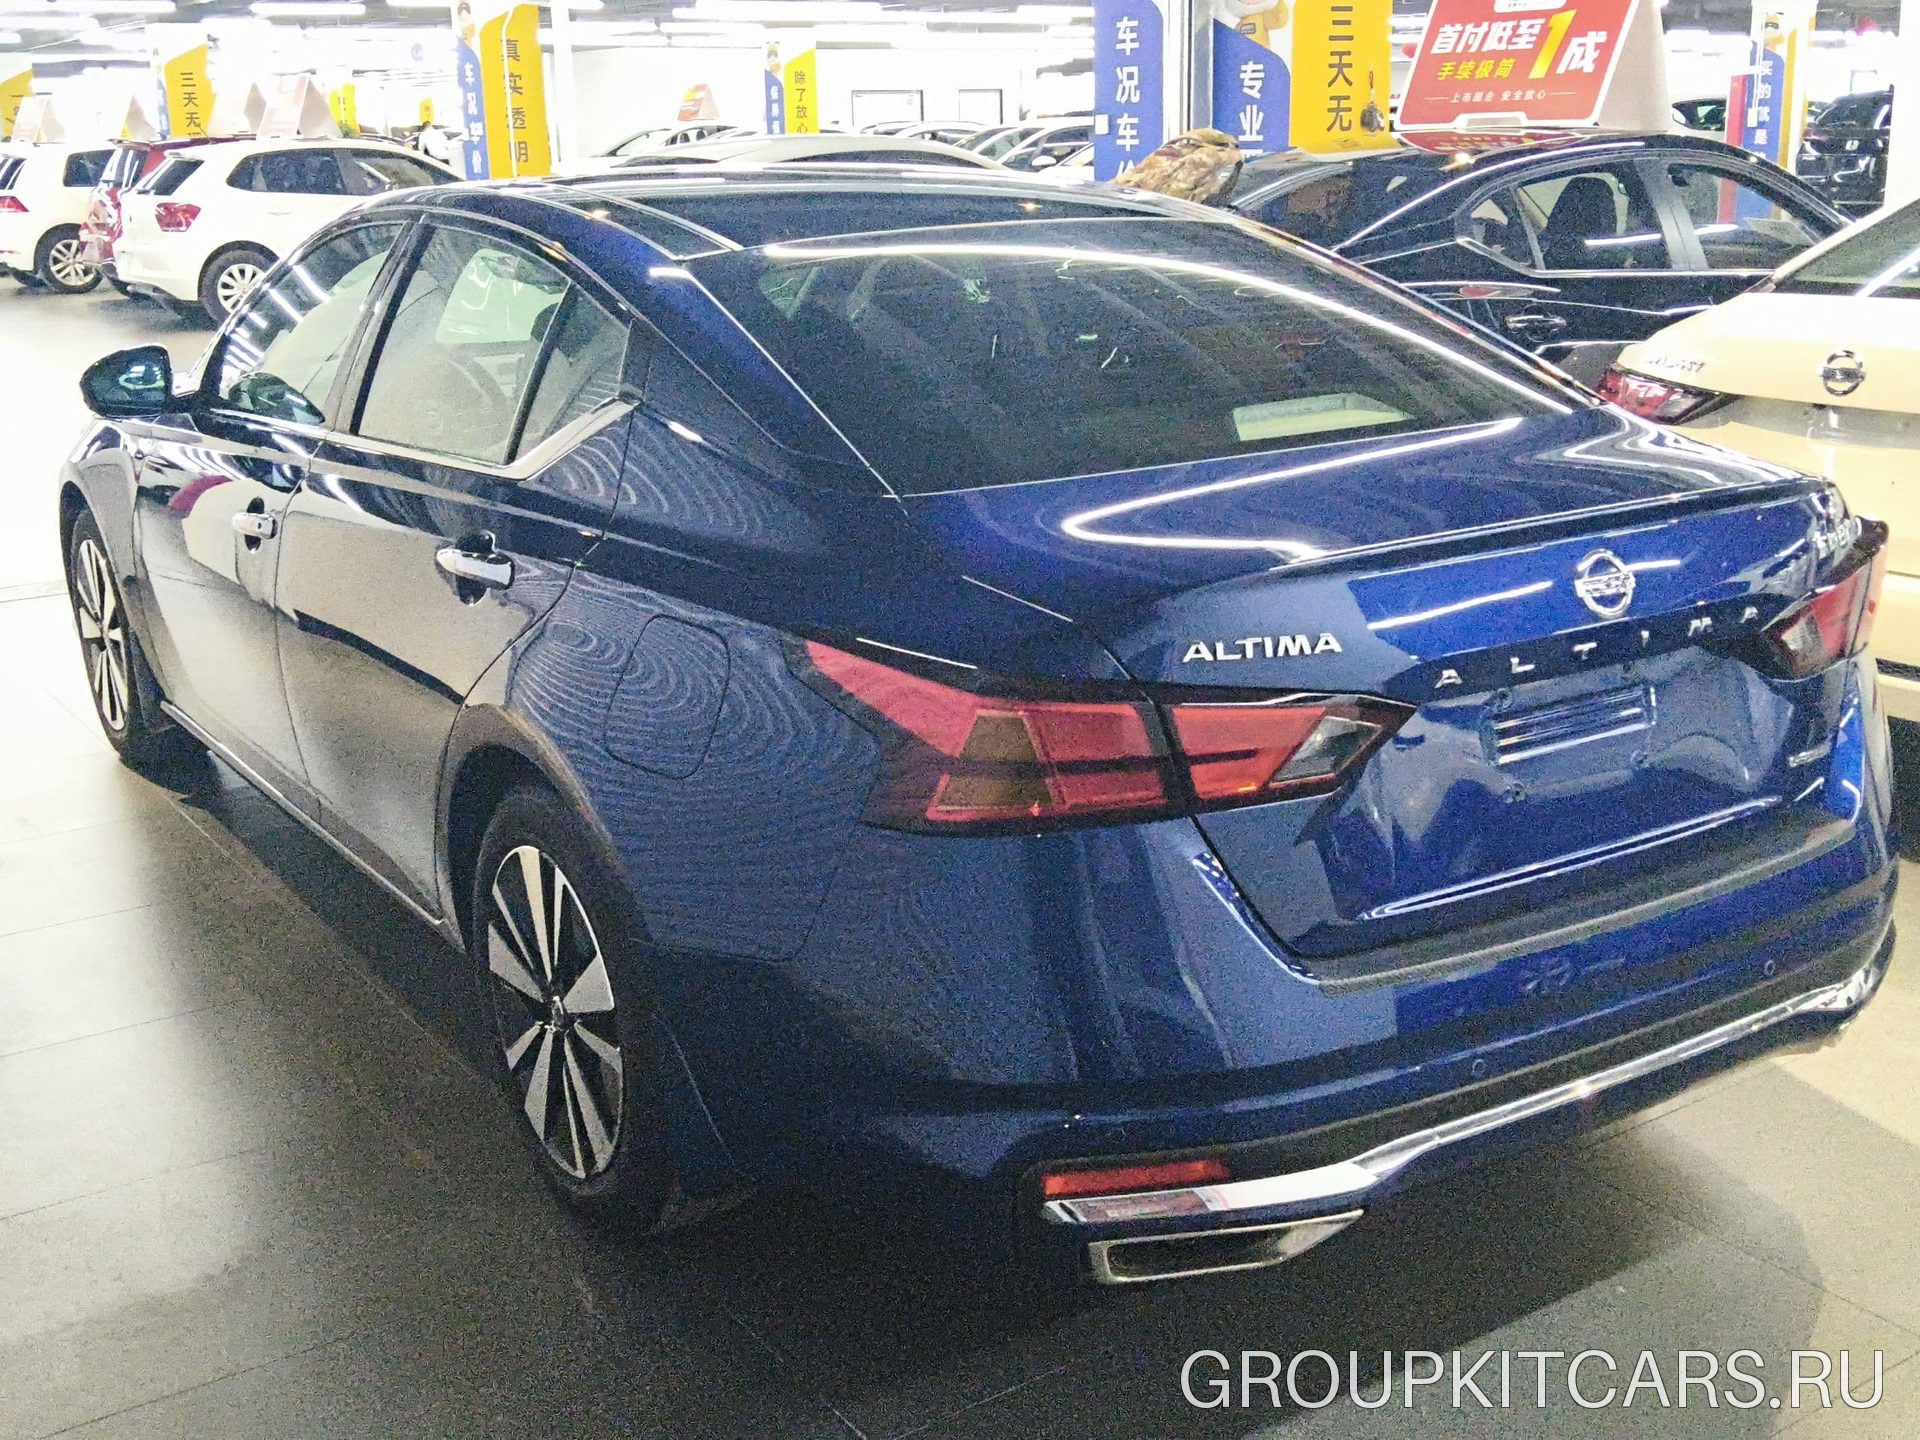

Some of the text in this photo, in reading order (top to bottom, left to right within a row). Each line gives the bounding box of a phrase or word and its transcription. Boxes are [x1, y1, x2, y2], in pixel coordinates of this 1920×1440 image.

[1327, 5, 1354, 132] 三天无
[1436, 57, 1517, 81] 手续极简
[180, 72, 202, 136] 三天无
[794, 70, 809, 134] 除了放心
[1238, 60, 1265, 154] 专业
[1182, 632, 1343, 663] ALTIMA
